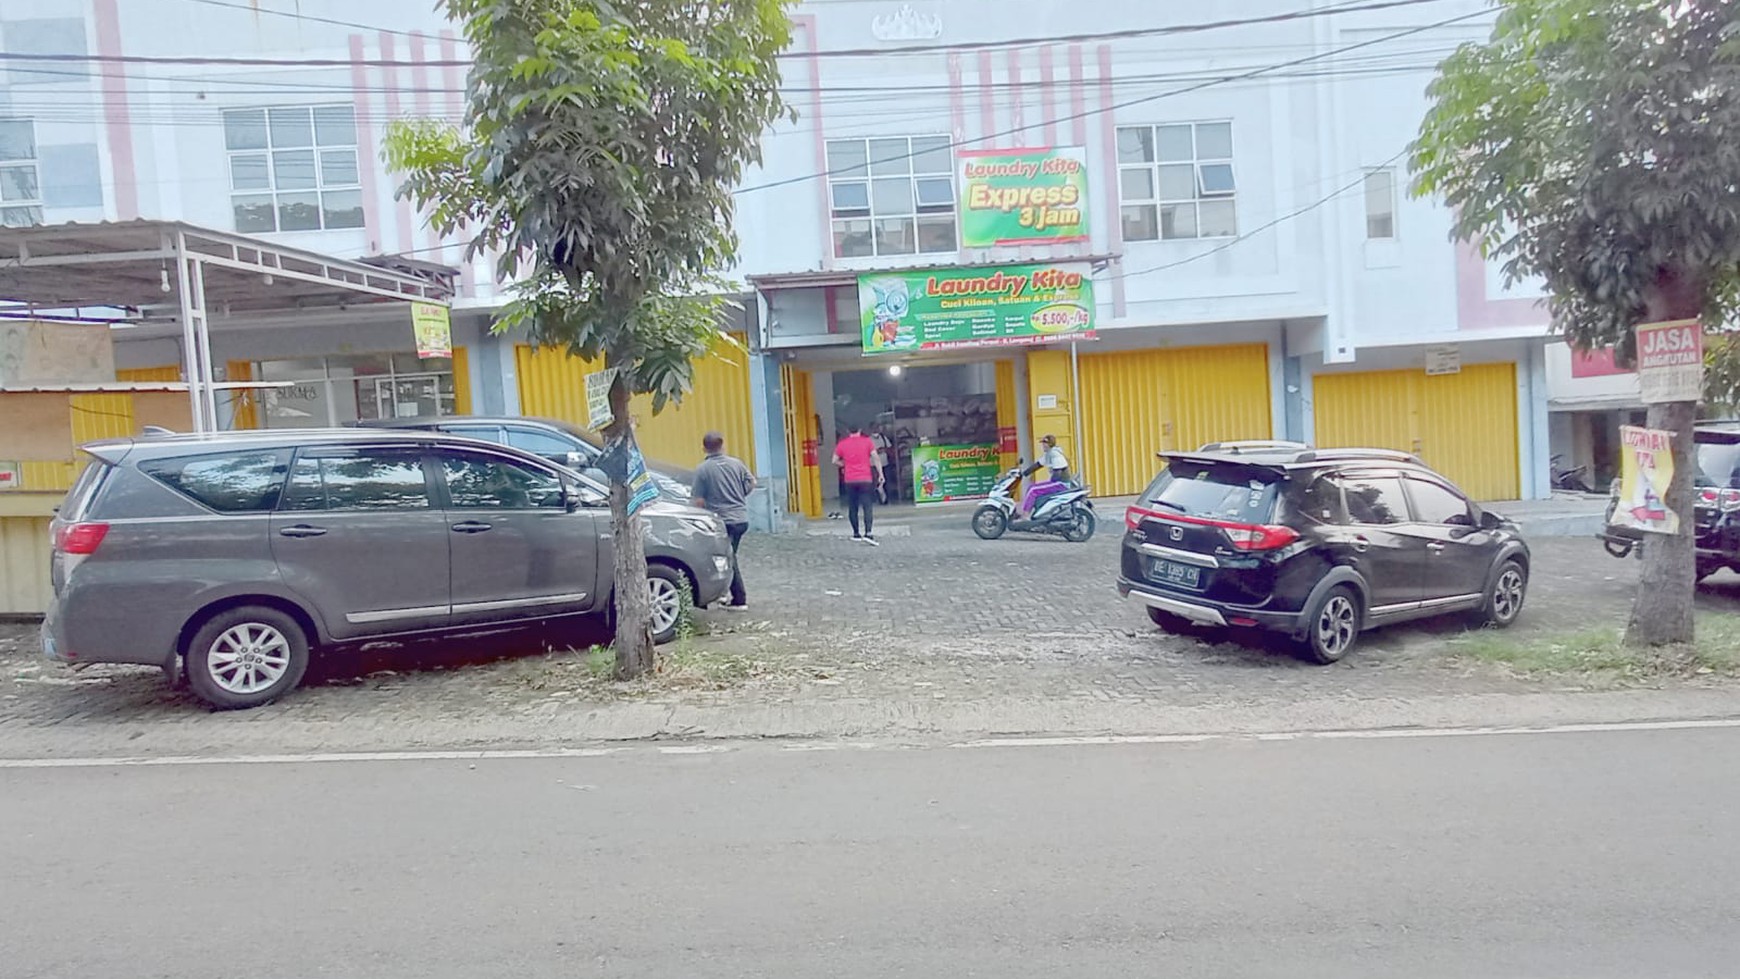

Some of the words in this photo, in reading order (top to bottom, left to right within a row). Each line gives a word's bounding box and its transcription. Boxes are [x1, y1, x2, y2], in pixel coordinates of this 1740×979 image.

[965, 159, 1037, 179] Laundry
[1041, 158, 1080, 174] Kita
[970, 184, 1079, 212] Express
[1019, 207, 1034, 227] 3
[926, 271, 1027, 297] Laundry
[1030, 268, 1081, 291] Kita
[1644, 328, 1694, 354] JASA
[1643, 351, 1697, 368] ANGKUTAN
[939, 446, 989, 460] Laundry
